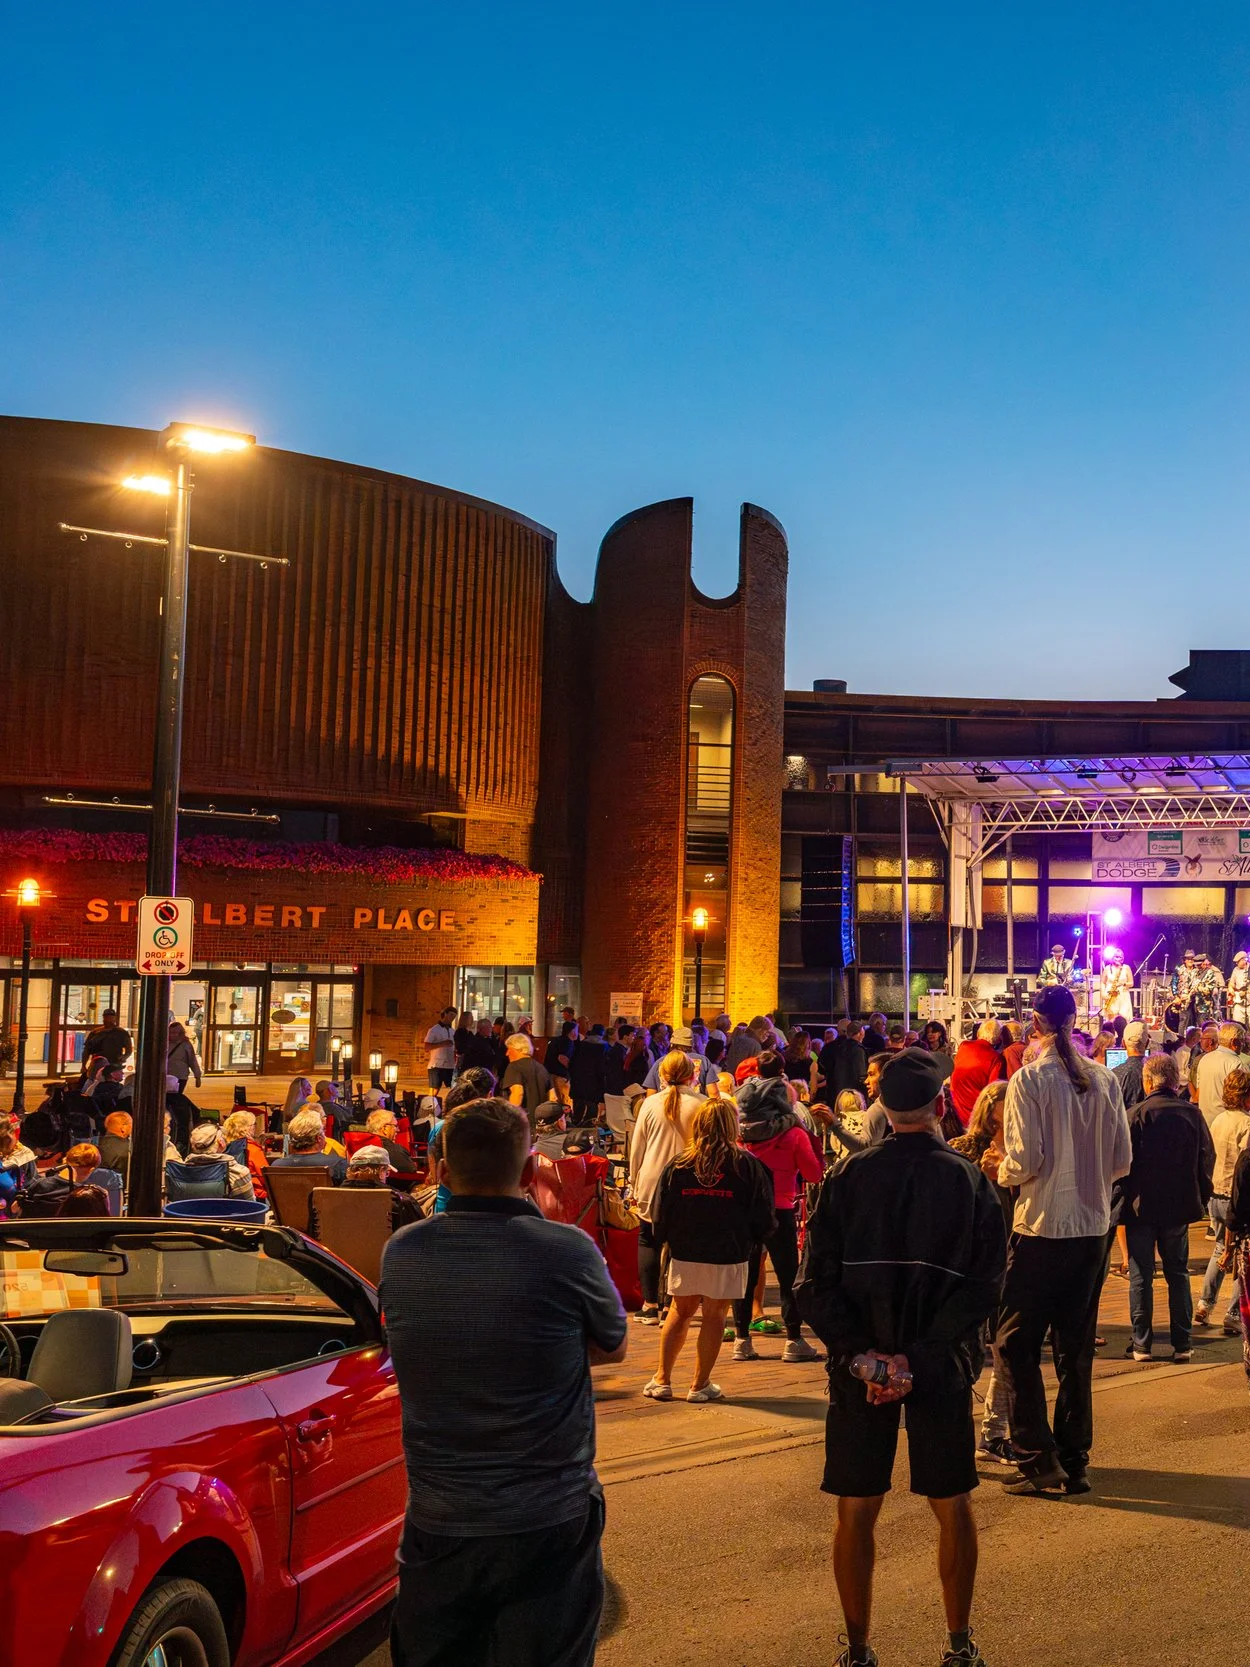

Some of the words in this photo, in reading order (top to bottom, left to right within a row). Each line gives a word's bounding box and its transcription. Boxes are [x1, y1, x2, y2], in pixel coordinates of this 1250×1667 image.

[1115, 861, 1158, 869] ALBERT
[1097, 869, 1157, 878] DODGE
[193, 902, 327, 927] LBERT
[353, 907, 457, 931] PLACE
[145, 951, 167, 959] DROP
[154, 959, 175, 967] ONLY
